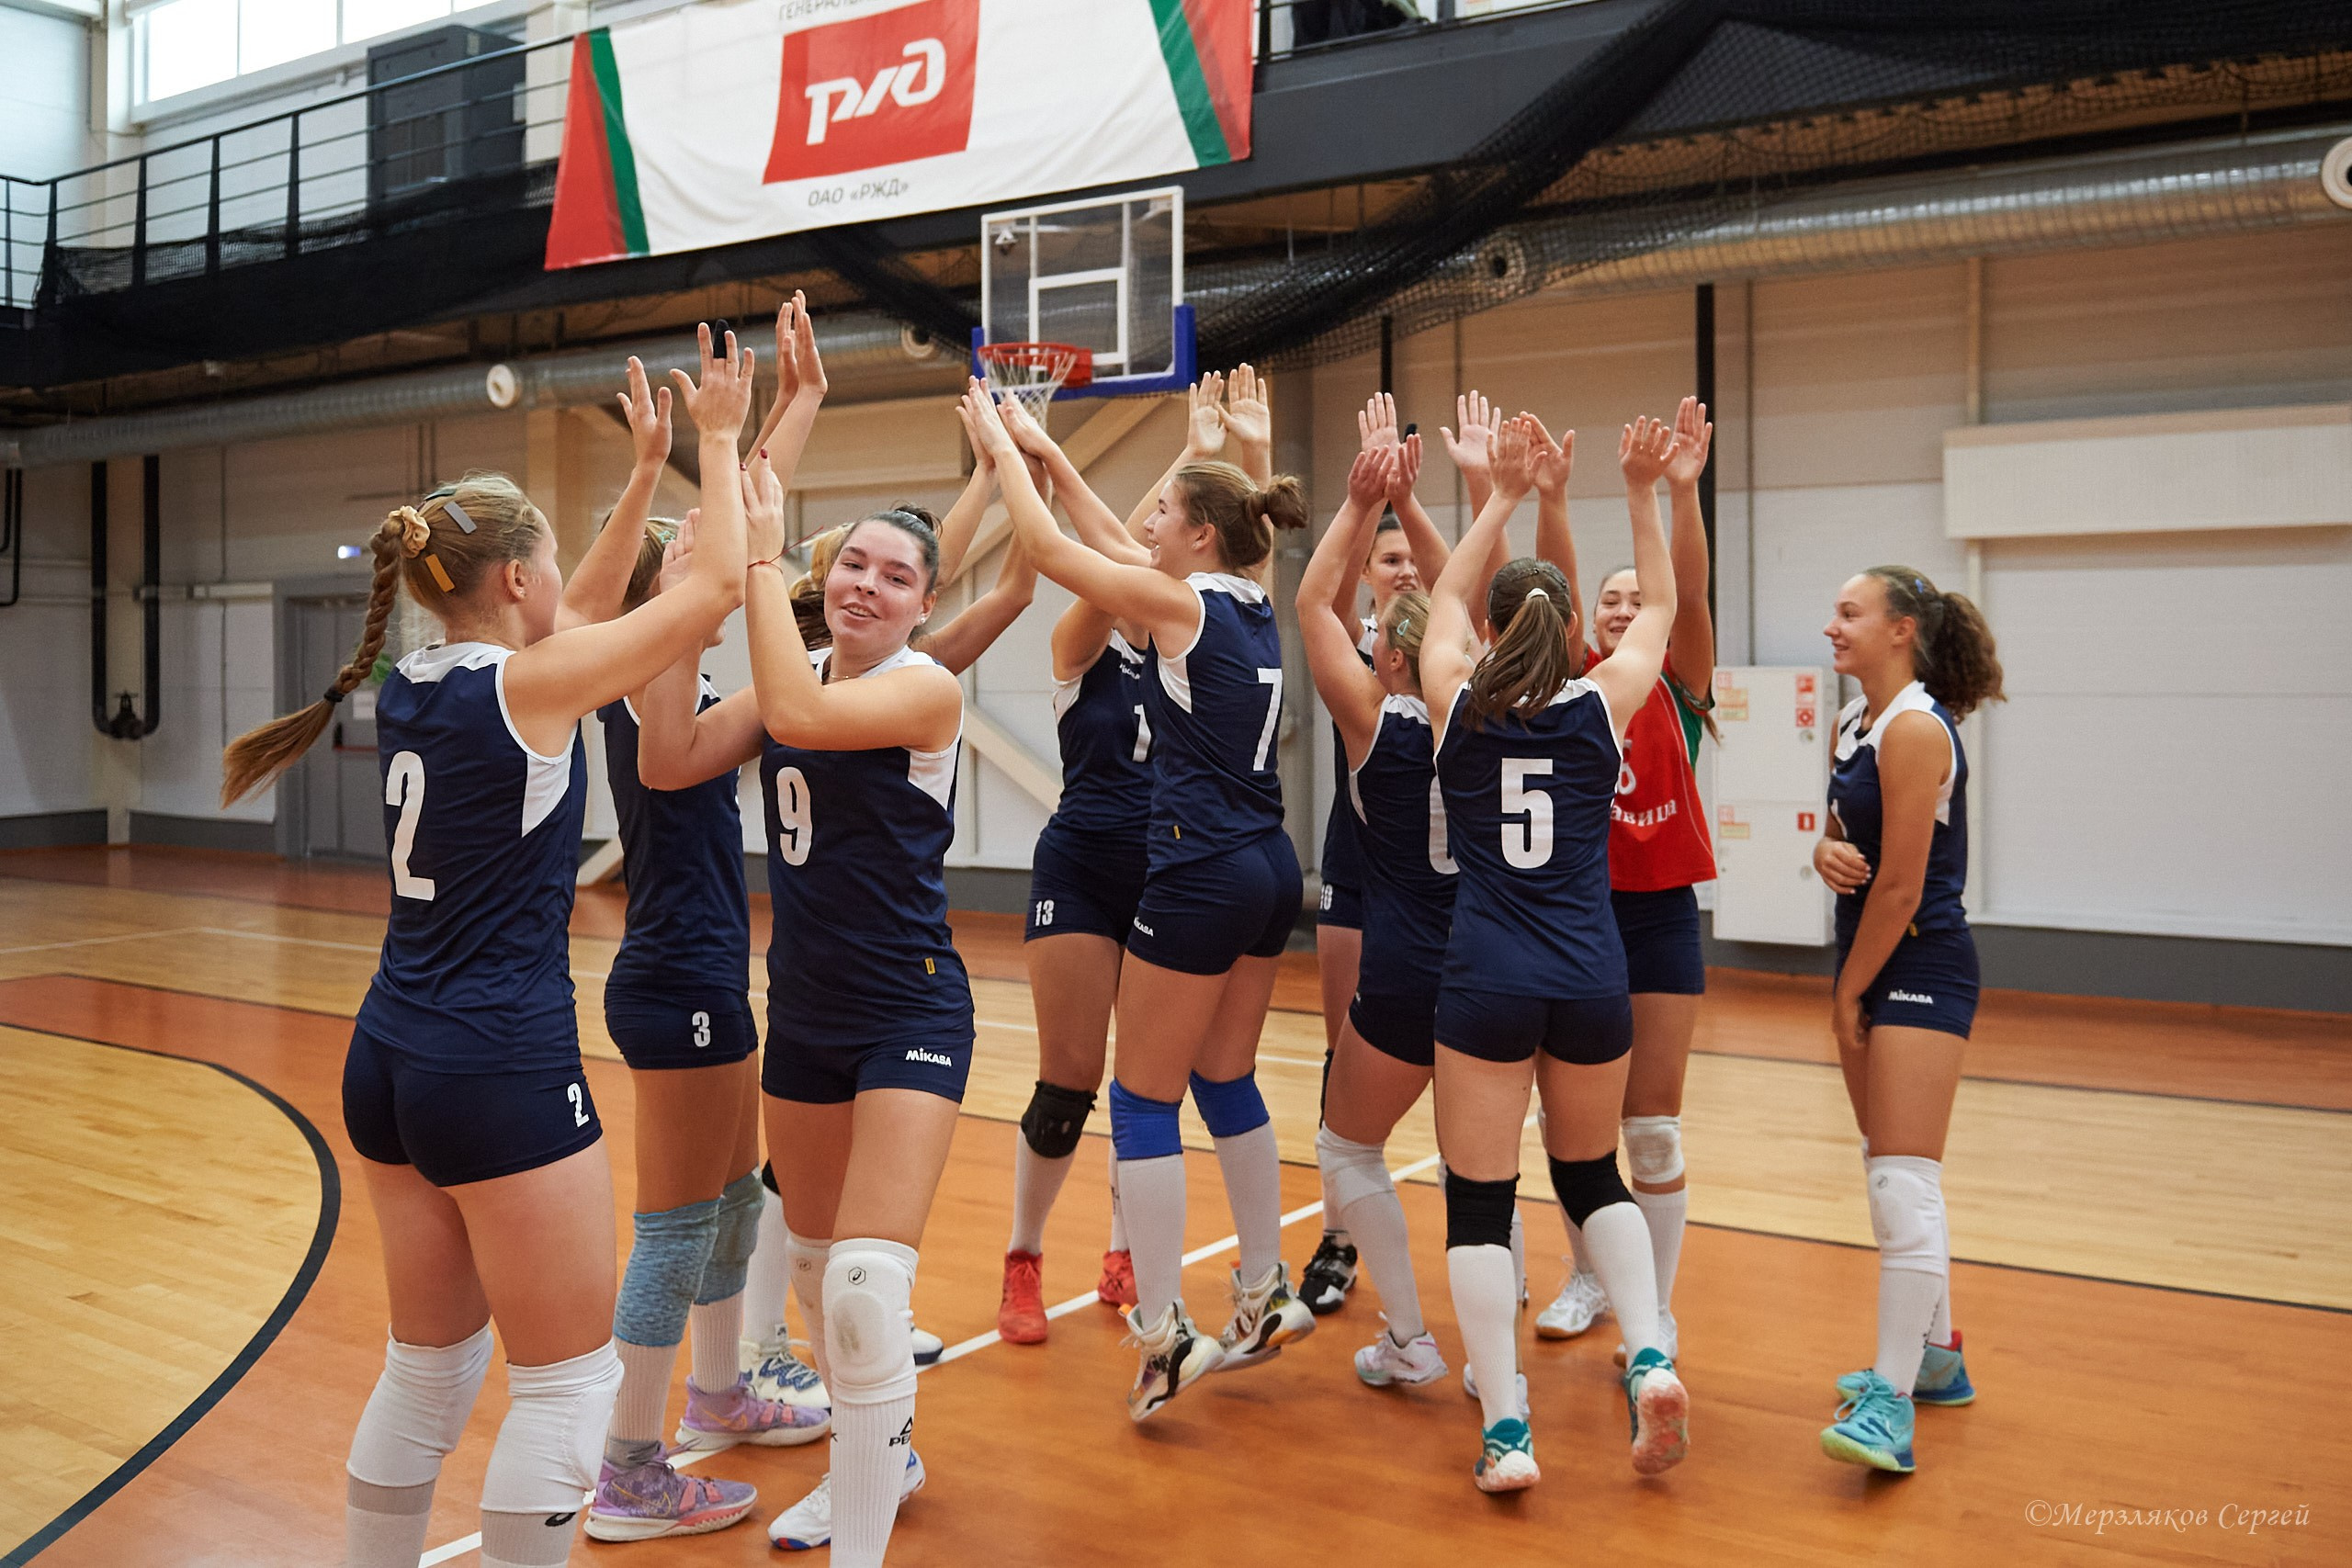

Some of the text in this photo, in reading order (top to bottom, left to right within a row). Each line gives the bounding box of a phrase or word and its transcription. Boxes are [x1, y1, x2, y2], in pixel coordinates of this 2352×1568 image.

[808, 178, 910, 206] ОАО «РЖД»
[1252, 668, 1283, 771] 7
[385, 750, 435, 901] 2
[776, 766, 813, 866] 9
[1500, 758, 1554, 869] 5
[1035, 899, 1055, 926] 13
[692, 1010, 711, 1047] 3
[567, 1082, 590, 1128] 2
[888, 1434, 910, 1447] PE
